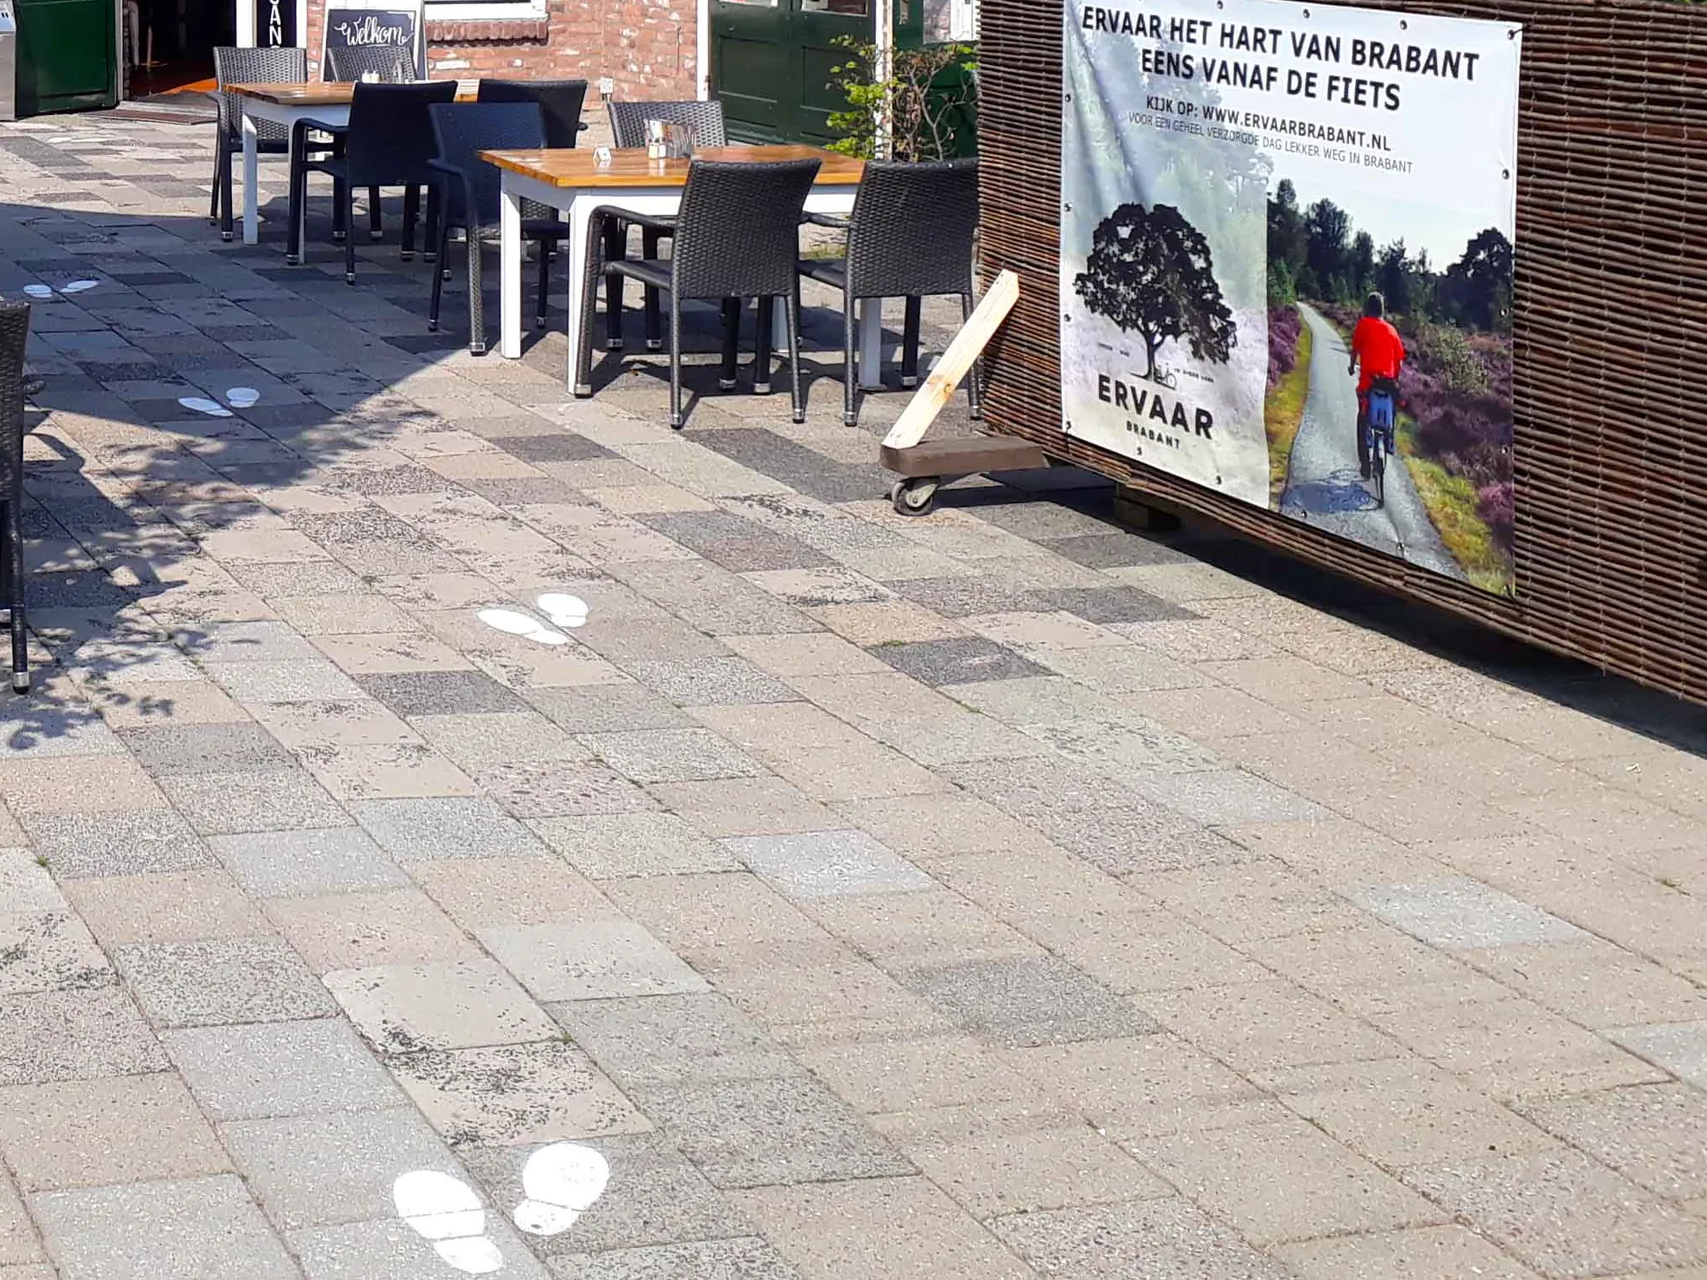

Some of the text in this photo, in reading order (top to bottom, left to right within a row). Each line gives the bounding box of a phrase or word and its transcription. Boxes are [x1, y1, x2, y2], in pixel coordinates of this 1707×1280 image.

[335, 15, 414, 46] Welkom
[1082, 5, 1480, 80] ERVAAR HET HART VAN BRABANT
[1142, 48, 1401, 111] EENS VANAF DE FIETS
[1128, 111, 1152, 126] VOOR
[1155, 116, 1171, 129] EEN
[1207, 127, 1260, 146] VERZORGDE
[1263, 136, 1282, 150] DAG
[1285, 140, 1320, 157] LEKKER
[1323, 148, 1346, 162] WEG
[1349, 152, 1360, 164] IN
[1364, 154, 1414, 174] BRABANT
[1146, 94, 1392, 152] KIJK OP: WWW.ERVAARBRABANT.NL
[1098, 374, 1213, 440] ERVAAR
[1126, 420, 1180, 449] BRABANT
